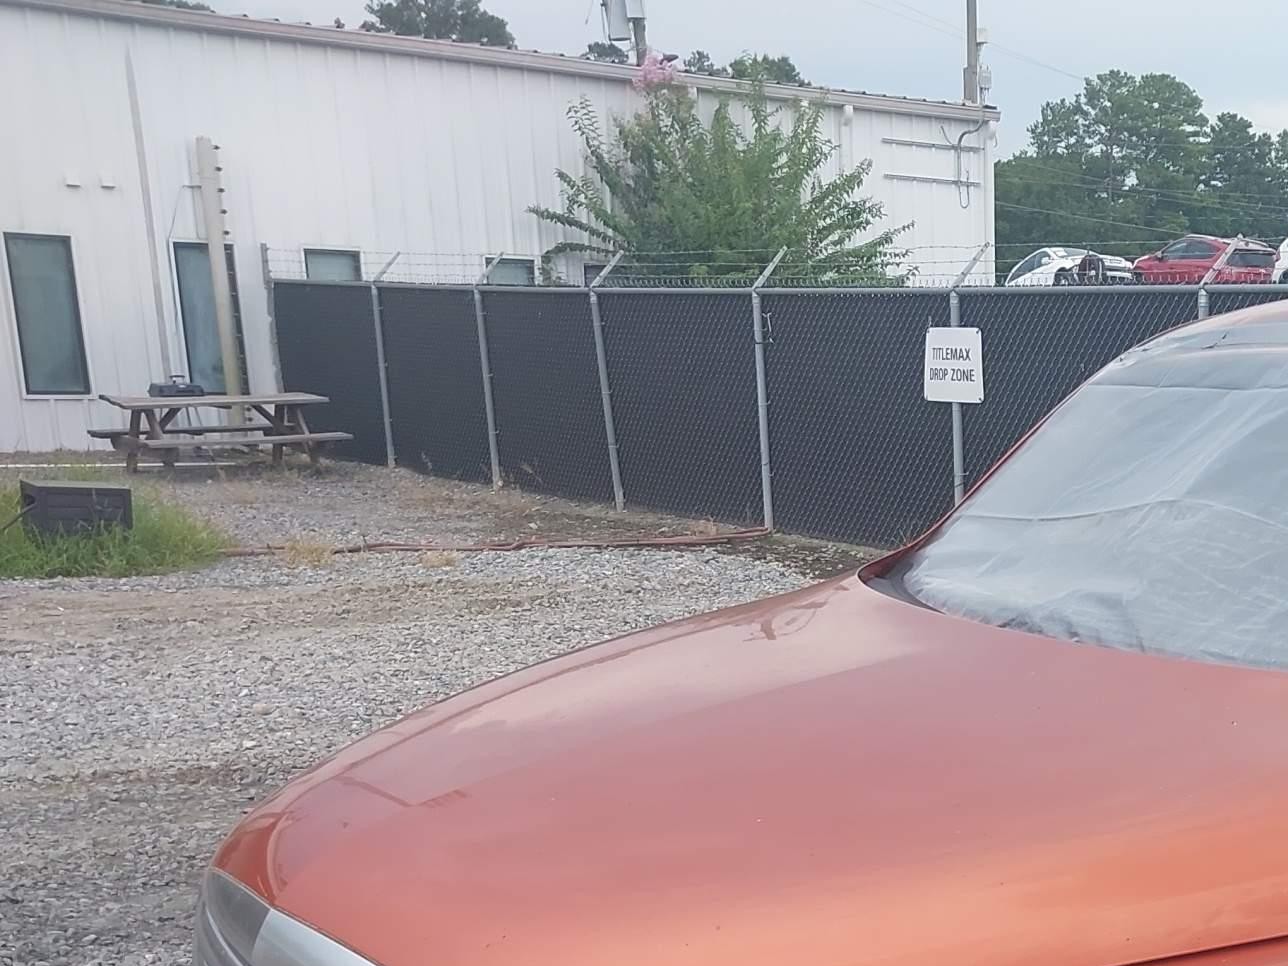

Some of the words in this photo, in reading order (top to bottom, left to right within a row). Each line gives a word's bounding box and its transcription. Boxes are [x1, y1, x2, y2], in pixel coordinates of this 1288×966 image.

[932, 347, 972, 361] TITLEMAX
[929, 367, 949, 381] DROP
[950, 368, 976, 382] ZONE
